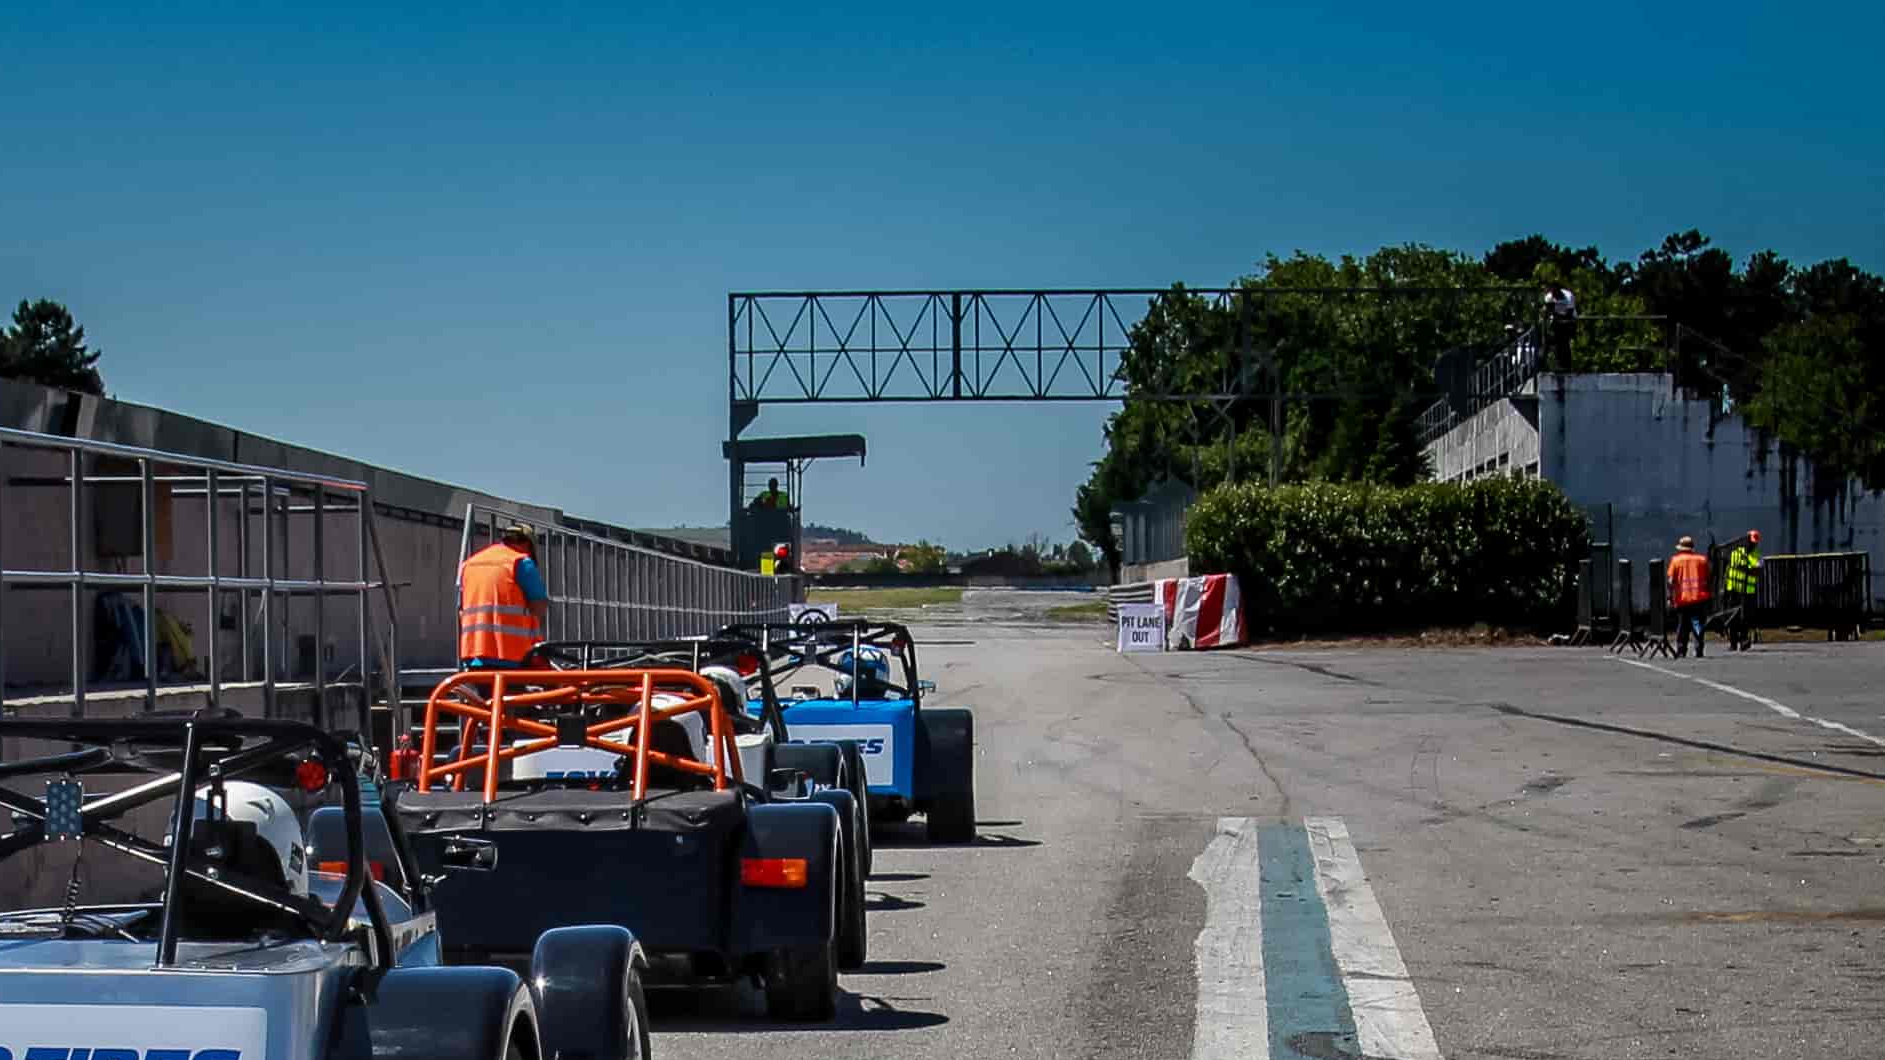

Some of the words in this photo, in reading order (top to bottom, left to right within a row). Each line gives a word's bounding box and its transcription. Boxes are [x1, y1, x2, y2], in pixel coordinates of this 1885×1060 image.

[1121, 615, 1135, 628] PIT
[1137, 615, 1162, 628] LANE
[1131, 631, 1149, 643] OUT
